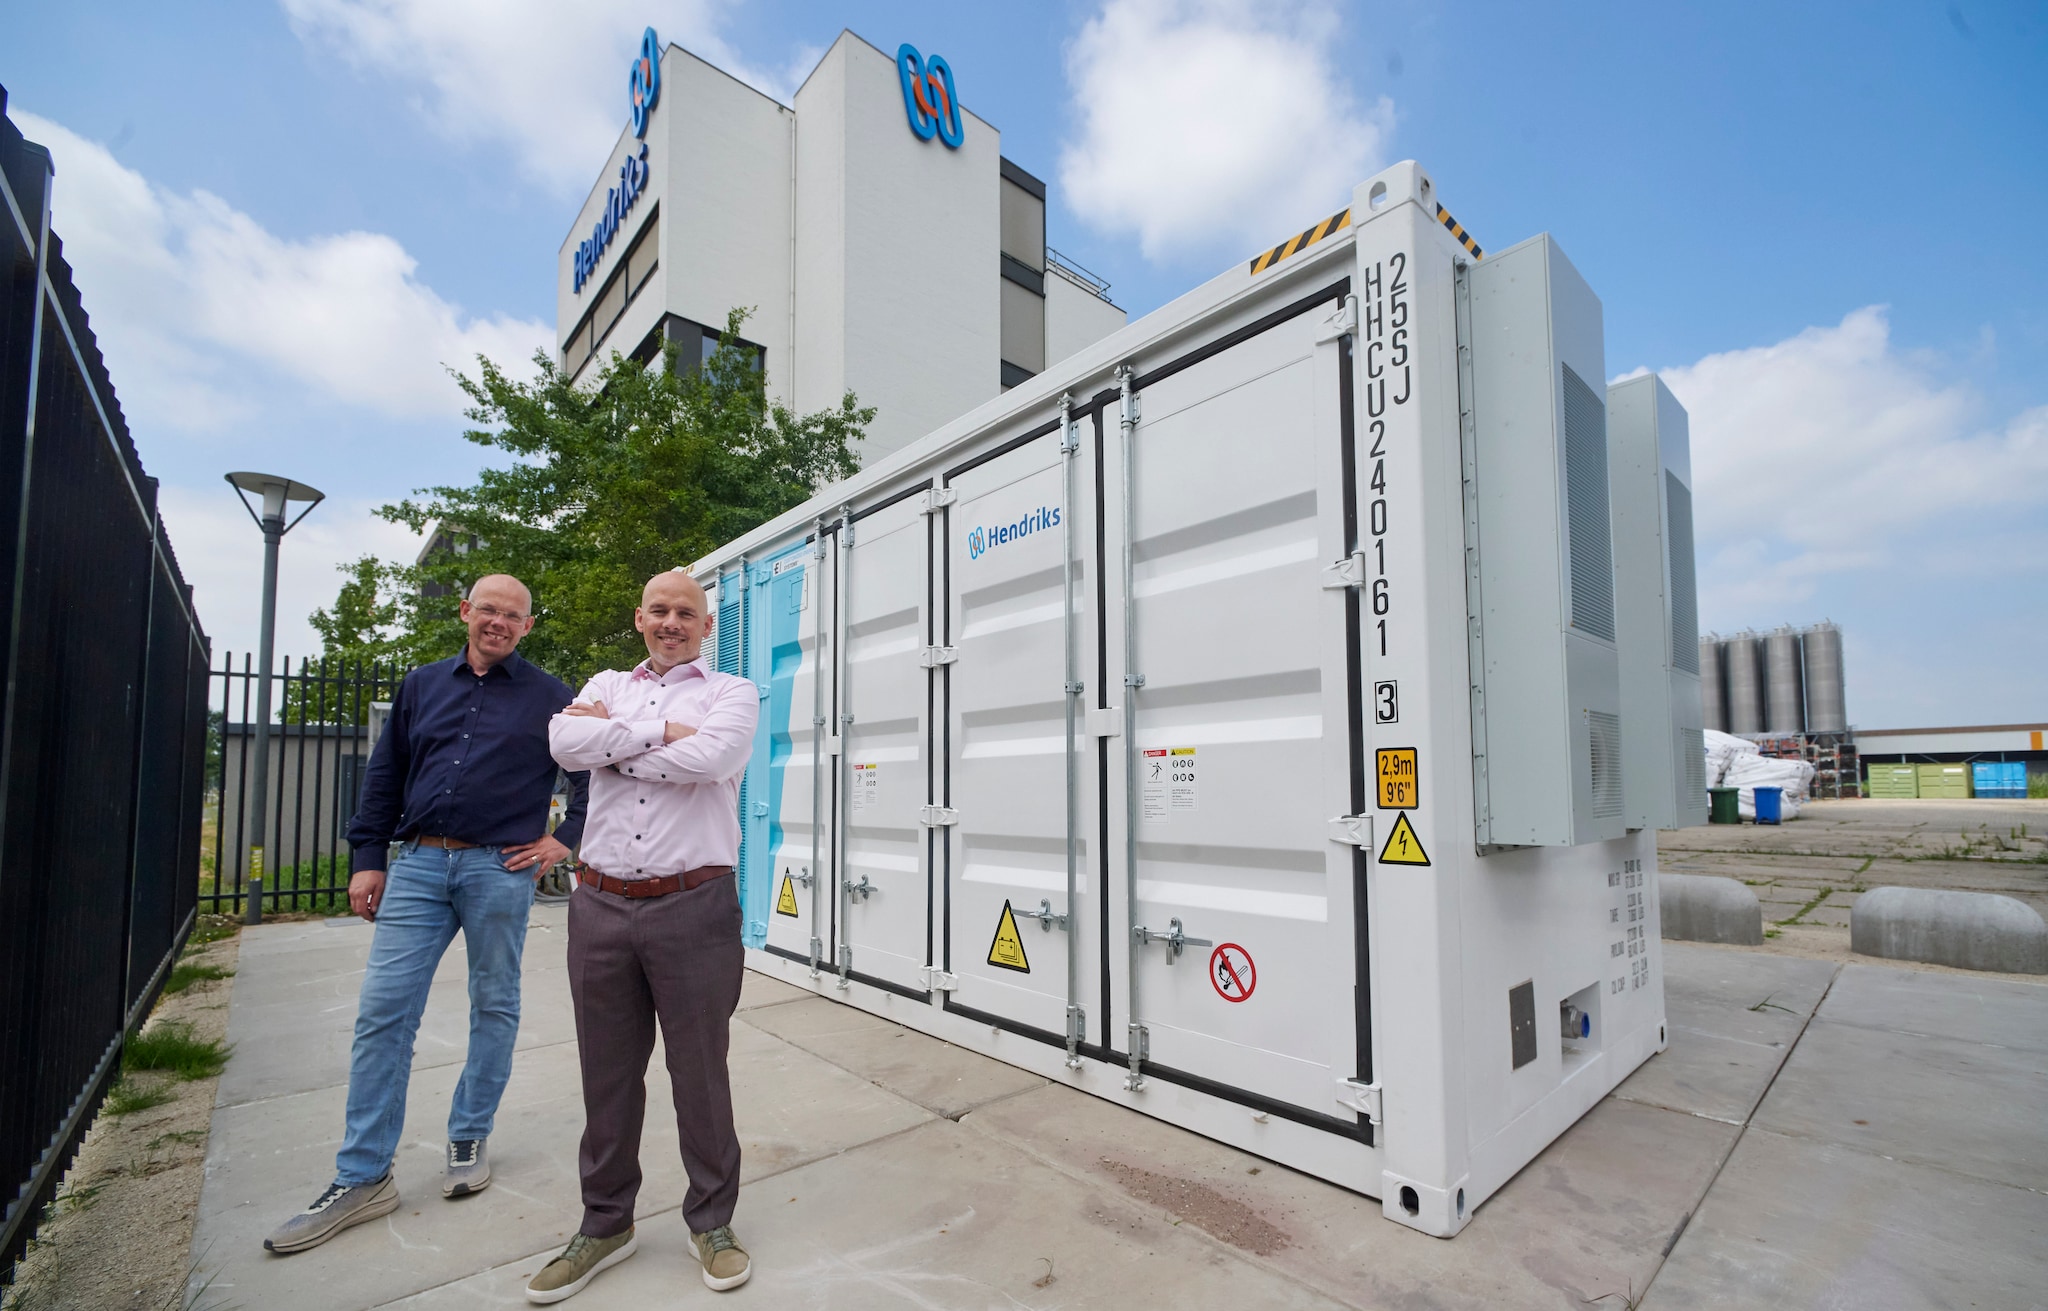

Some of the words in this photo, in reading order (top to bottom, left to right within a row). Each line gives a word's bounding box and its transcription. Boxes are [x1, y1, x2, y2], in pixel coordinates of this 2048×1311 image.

[573, 143, 649, 294] Hendriks
[989, 506, 1060, 548] Hendriks
[1378, 683, 1395, 721] 3
[1382, 755, 1412, 779] 2,9m
[1386, 782, 1411, 803] 9'6"
